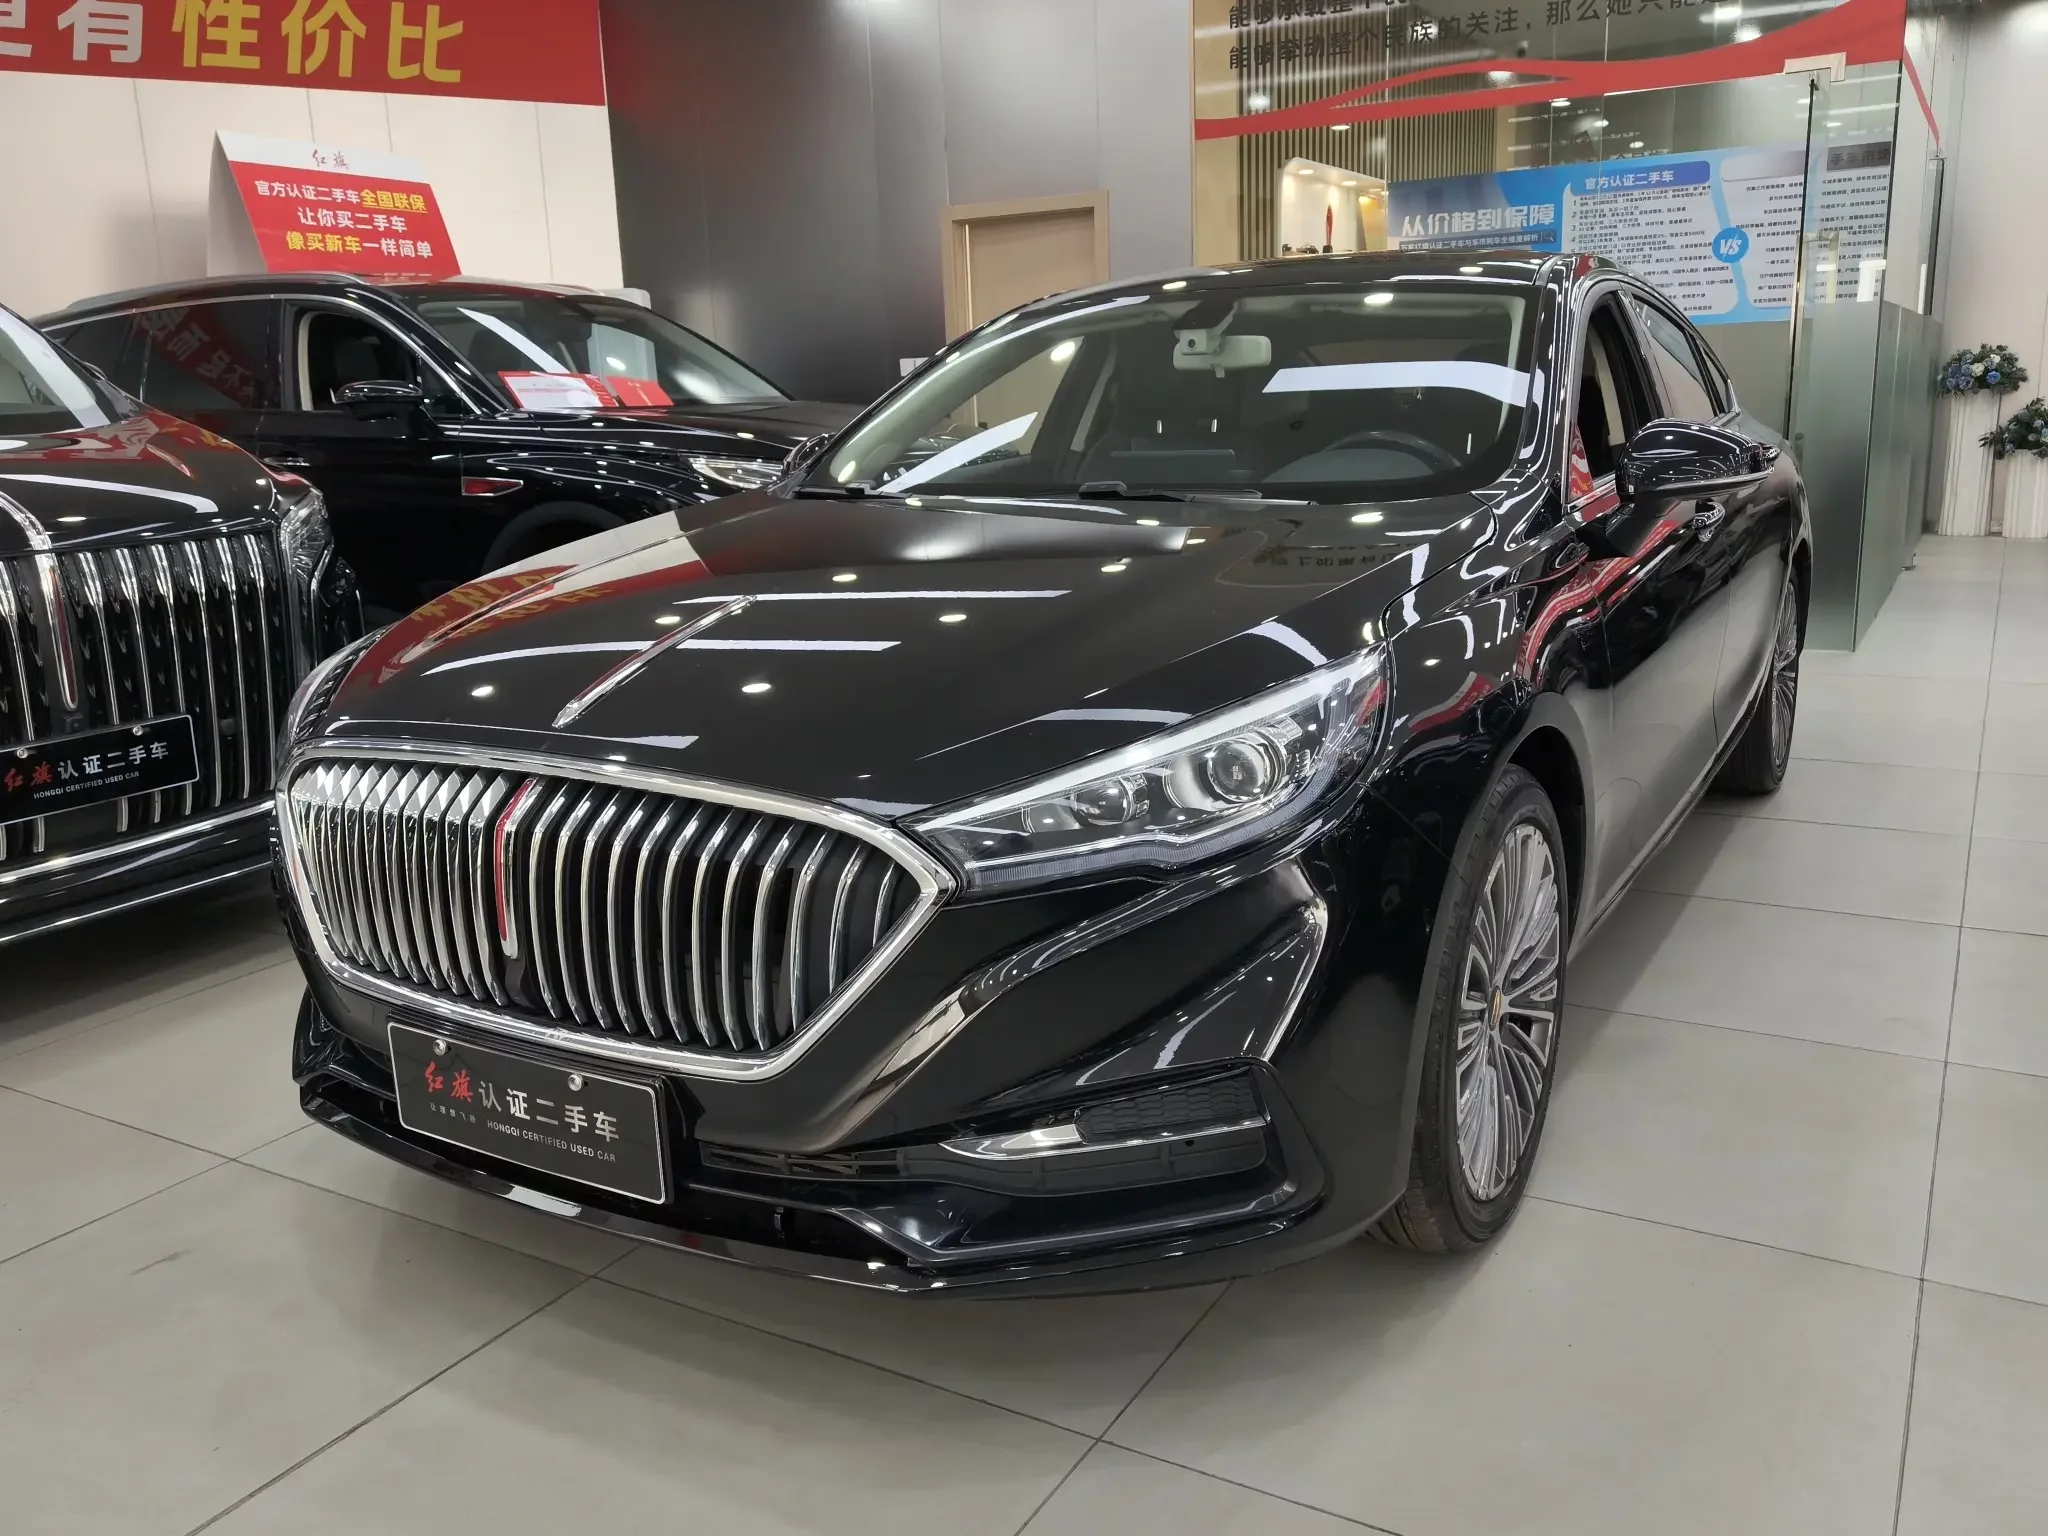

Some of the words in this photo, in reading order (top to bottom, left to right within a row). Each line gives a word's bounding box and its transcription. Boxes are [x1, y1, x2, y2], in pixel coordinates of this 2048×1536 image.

[1585, 170, 1675, 191] 官方认证二手车
[297, 206, 408, 233] 让你买二手车
[1402, 203, 1555, 237] 从价格到保障
[286, 230, 434, 259] 像买新车一样简单
[1719, 238, 1743, 256] VS
[33, 788, 64, 800] HONGQI
[65, 779, 103, 793] CERTIFIED
[105, 774, 124, 784] USED
[125, 771, 140, 780] CAR
[487, 1119, 520, 1137] HONGQI
[522, 1129, 568, 1150] CERTIFIED
[570, 1144, 595, 1157] USED
[597, 1150, 616, 1163] CAR
